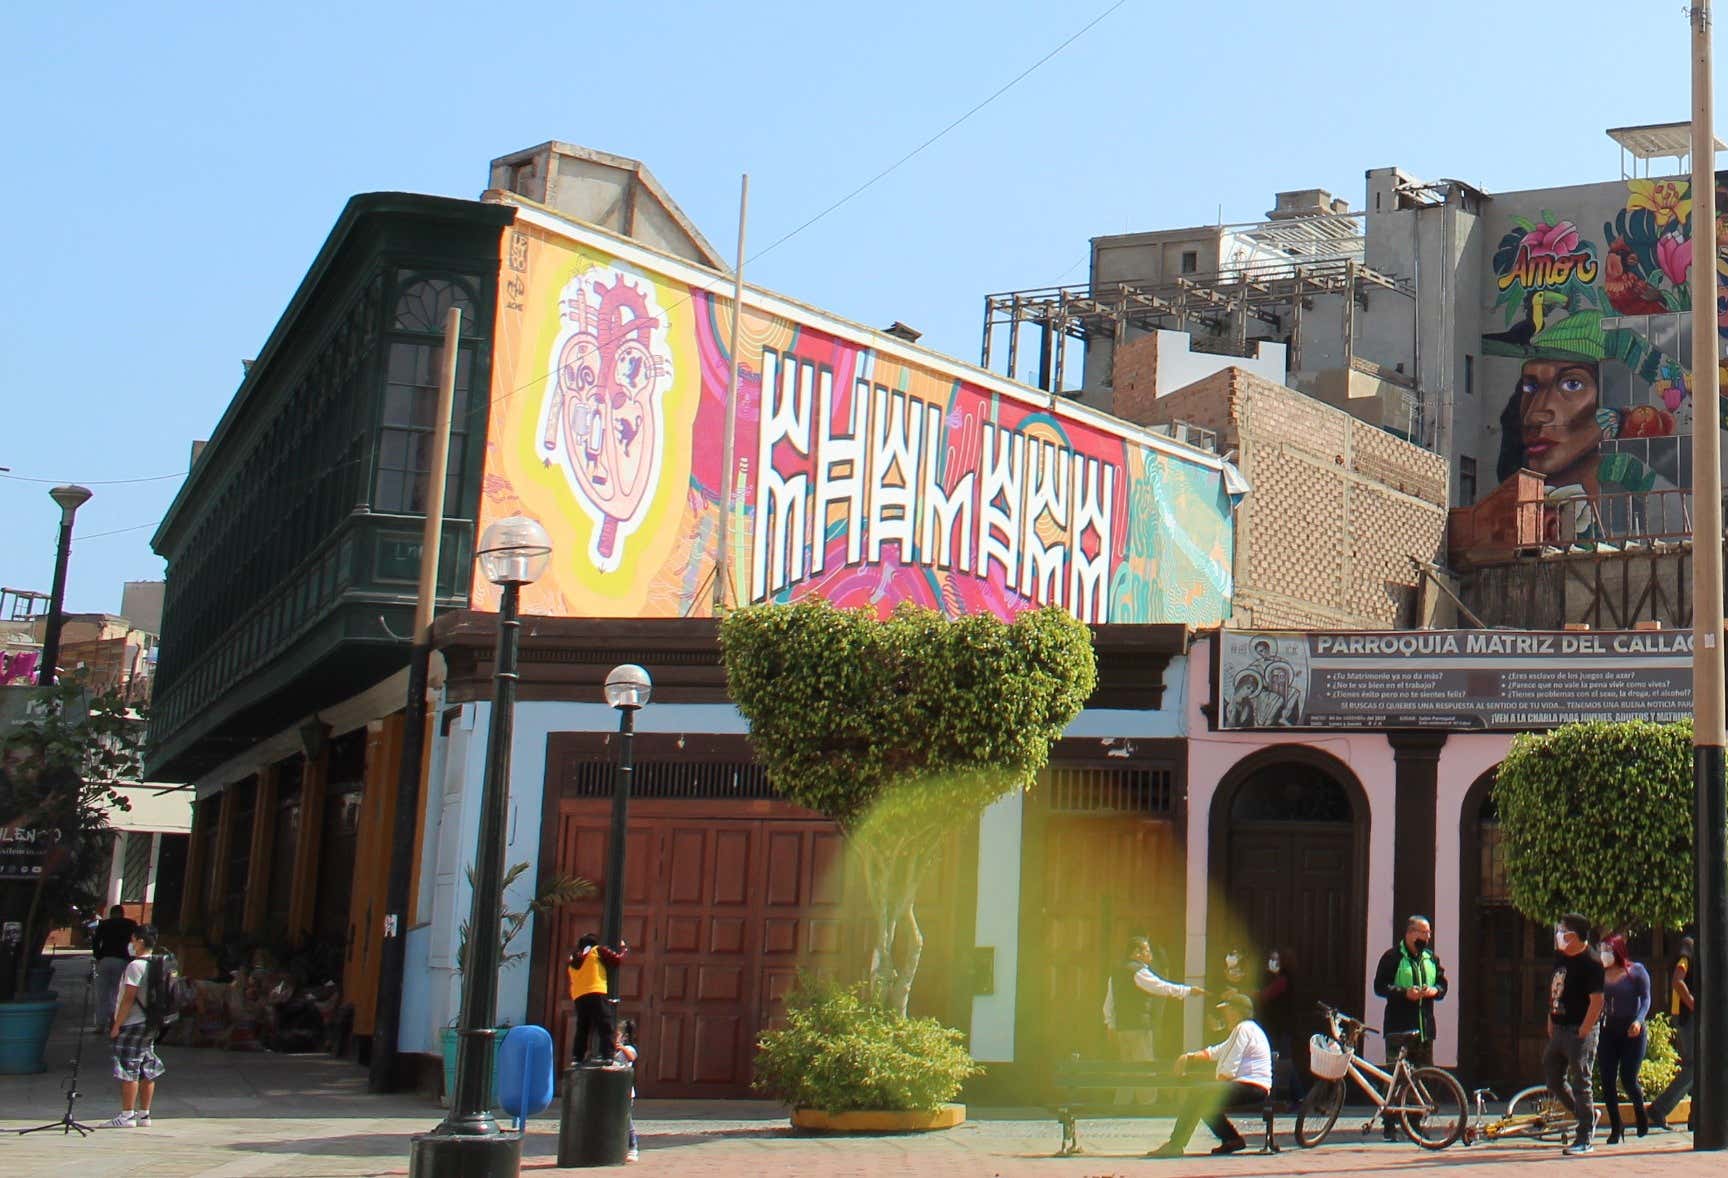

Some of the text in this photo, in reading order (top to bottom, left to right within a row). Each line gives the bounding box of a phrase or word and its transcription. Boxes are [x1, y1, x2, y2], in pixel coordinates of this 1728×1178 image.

[1497, 244, 1599, 292] Amor
[1317, 635, 1460, 657] PARROQUIA
[1466, 634, 1555, 655] MATRIZ
[1562, 635, 1607, 654] DEL
[1557, 671, 1566, 681] de
[1567, 671, 1578, 681] los
[1579, 671, 1603, 681] juegos
[1604, 671, 1614, 681] de
[1368, 681, 1385, 690] bien
[1386, 681, 1395, 690] en
[1397, 681, 1404, 690] el
[1405, 681, 1436, 690] trabajo?
[1538, 681, 1552, 690] que
[1553, 681, 1563, 690] no
[1580, 681, 1588, 690] la
[1589, 681, 1608, 690] pena
[1609, 681, 1625, 690] vivir
[1381, 690, 1398, 699] pero
[1399, 690, 1409, 699] no
[1410, 690, 1419, 699] te
[1420, 690, 1446, 699] sientes
[1536, 690, 1576, 699] problemas
[1577, 690, 1590, 699] con
[1591, 690, 1598, 699] el
[1619, 690, 1626, 699] la
[1652, 690, 1659, 699] el
[1661, 690, 1692, 699] alcohol?
[1386, 702, 1416, 711] QUIERES
[1417, 702, 1434, 710] UNA
[1435, 702, 1474, 710] RESPUESTA
[1486, 702, 1518, 710] SENTIDO
[1519, 702, 1529, 710] DE
[1567, 702, 1602, 710] TENEMOS
[1603, 702, 1620, 710] UNA
[1621, 702, 1645, 710] BUENA
[1646, 702, 1676, 710] NOTICIA
[1510, 712, 1516, 724] A
[1517, 712, 1526, 724] LA
[1527, 712, 1559, 724] CHARLA
[1559, 712, 1579, 724] PARA
